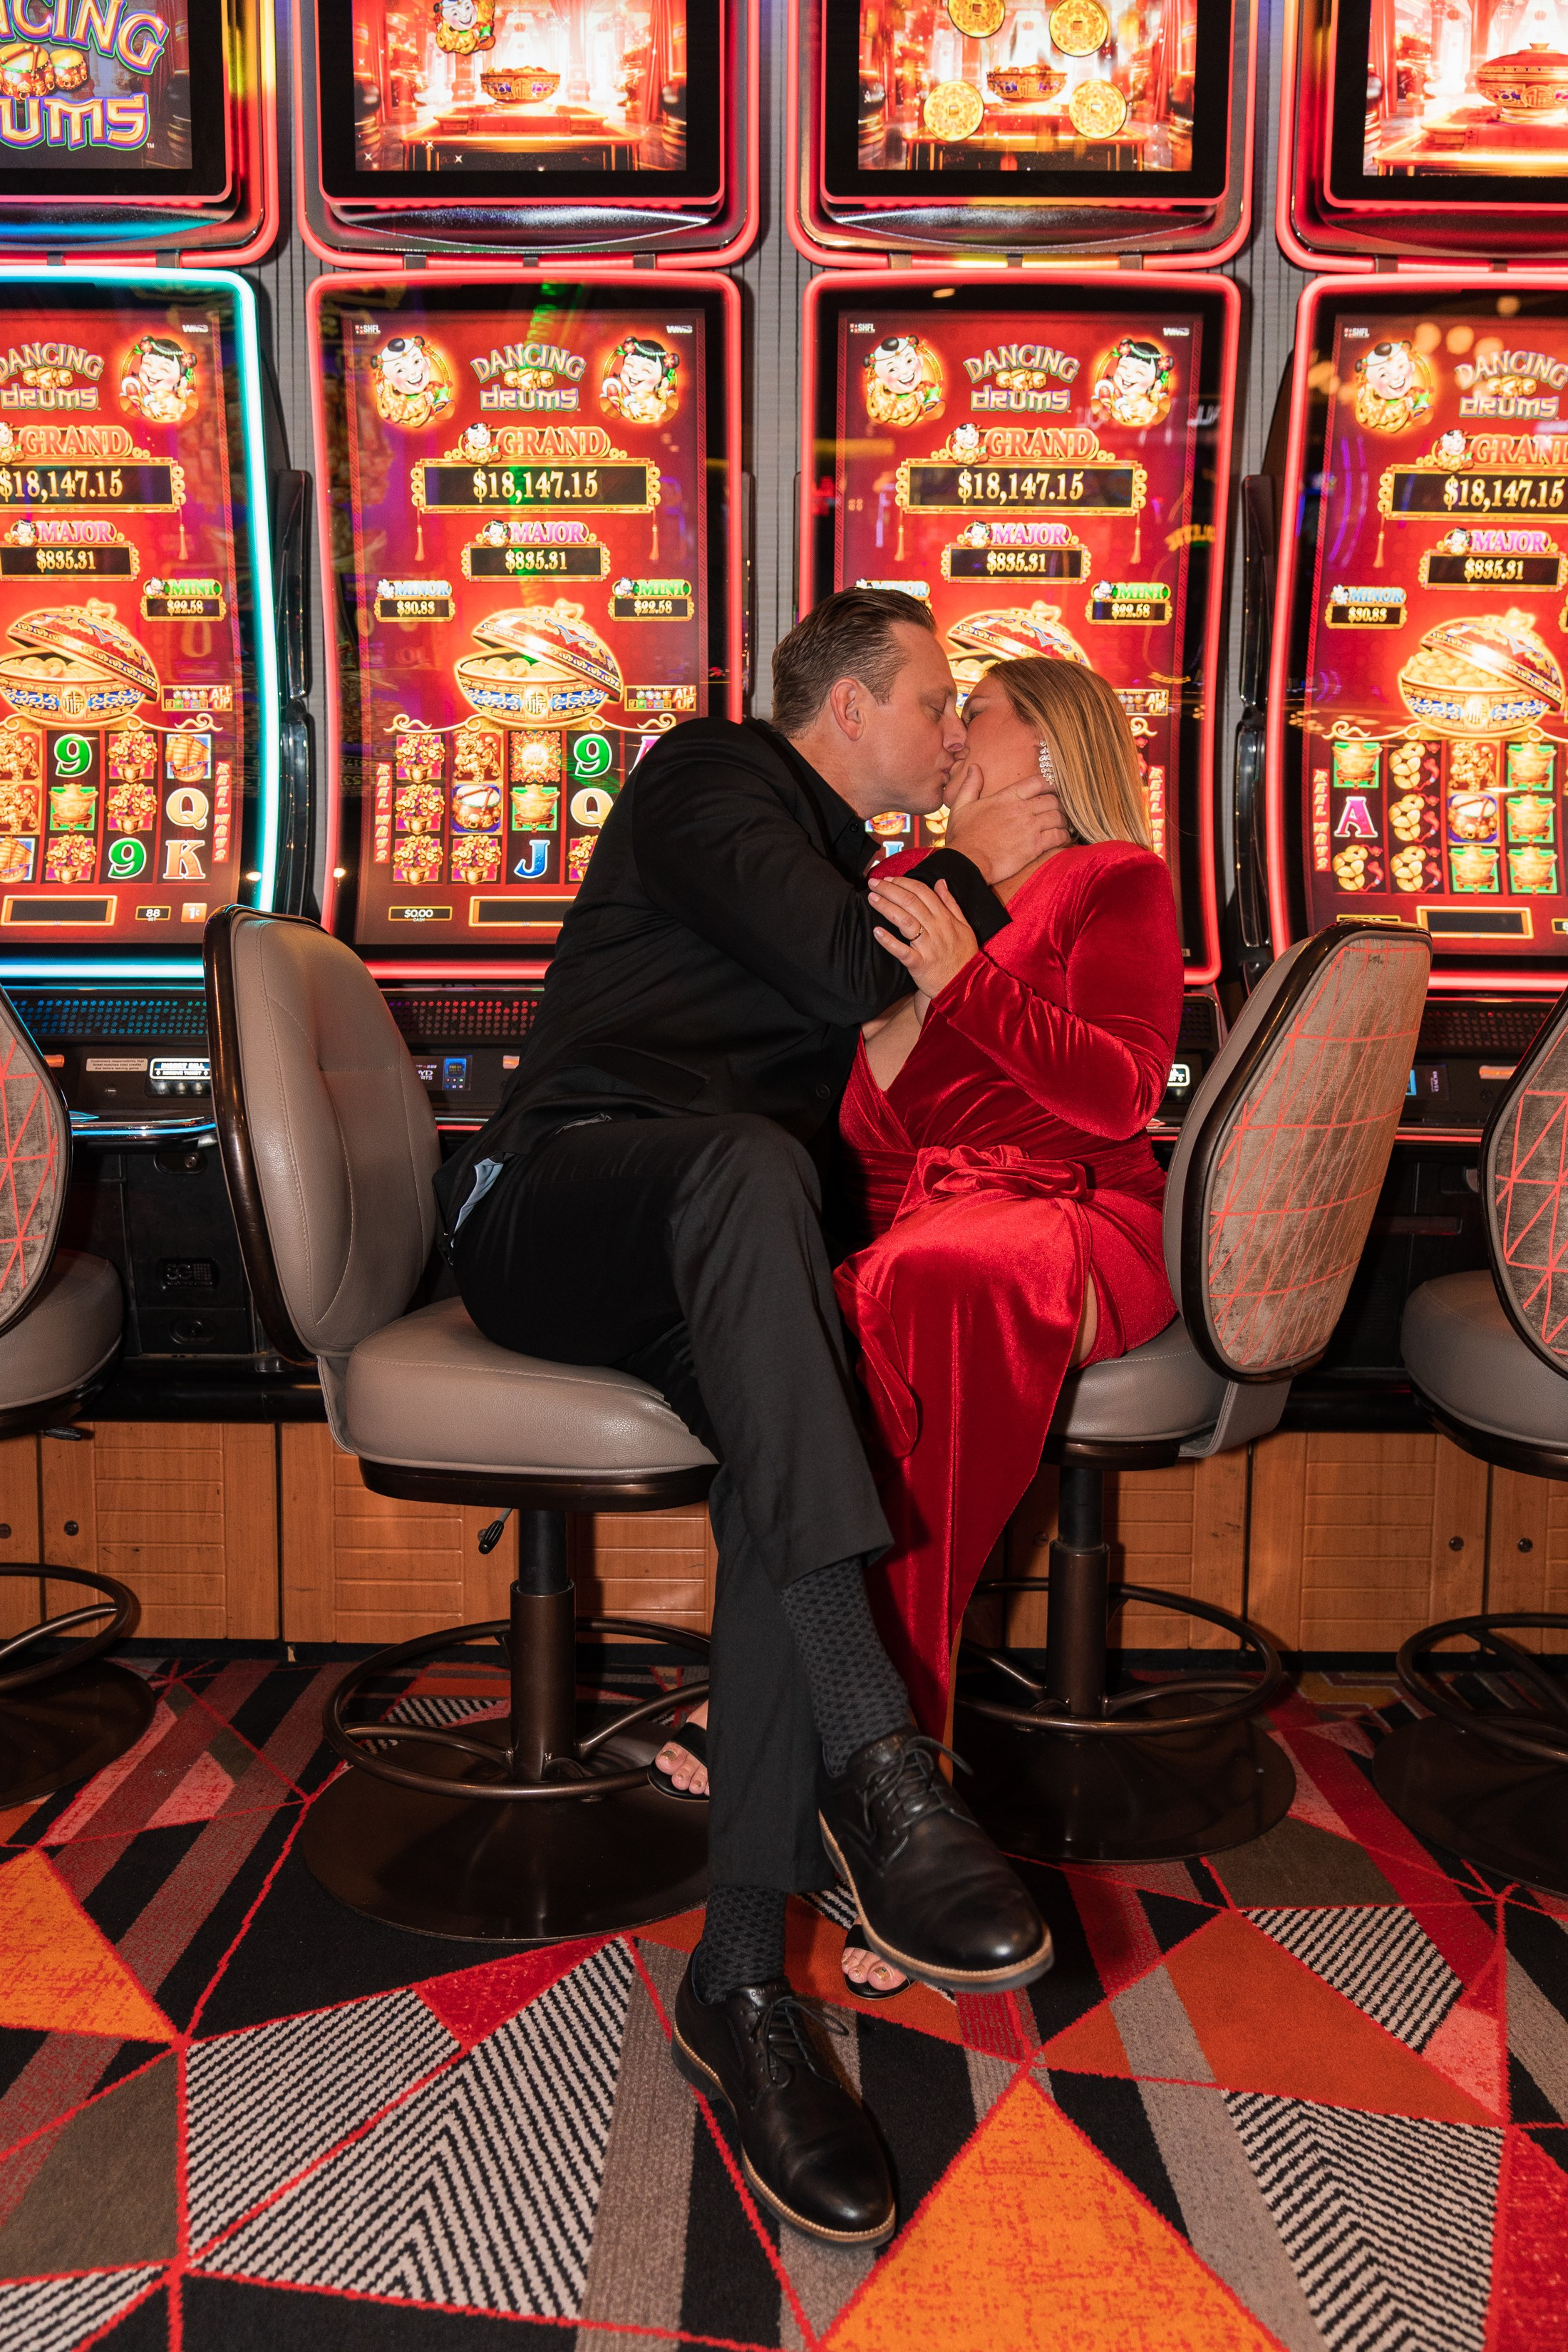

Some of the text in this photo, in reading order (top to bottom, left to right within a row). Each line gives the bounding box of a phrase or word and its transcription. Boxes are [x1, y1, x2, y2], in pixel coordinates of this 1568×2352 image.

[182, 324, 209, 333] WMS
[666, 325, 693, 334] WMS
[470, 344, 587, 383] DANCING
[964, 344, 1081, 383] DANCING
[1454, 350, 1568, 390] DANCING
[19, 425, 130, 458] GRAND
[499, 426, 607, 458] GRAND
[984, 428, 1096, 460] GRAND
[0, 468, 123, 502] $18,147.15
[473, 468, 598, 502] $18,147.15
[958, 469, 1084, 503] $18,147.15
[1443, 475, 1565, 512] $18,147.15
[37, 520, 114, 544] MAJOR
[508, 521, 585, 545] MAJOR
[991, 522, 1067, 547] MAJOR
[1472, 529, 1547, 554] MAJOR
[36, 549, 97, 573] $835.31
[505, 550, 567, 573] $835.31
[986, 550, 1046, 575] $835.31
[1463, 557, 1524, 582] $835.31
[167, 579, 216, 597] MINI
[394, 580, 450, 597] MINOR
[638, 579, 685, 597] MINI
[1116, 582, 1165, 600] MINI
[1349, 587, 1405, 603] MINOR
[166, 599, 204, 616] $22.58
[634, 599, 672, 617] $22.58
[1111, 604, 1150, 619] $22.58
[209, 686, 232, 703] ALL
[214, 696, 230, 709] UP
[672, 686, 696, 703] ALL
[677, 696, 694, 710] UP
[1145, 691, 1168, 706] ALL
[1150, 701, 1166, 713] UP
[54, 733, 92, 778] 9
[573, 733, 612, 778] 9
[166, 787, 210, 830] Q
[375, 763, 391, 862] REEL WAYS
[570, 788, 614, 829] Q
[1333, 796, 1378, 838] A
[214, 814, 231, 861] WAYS
[1314, 822, 1329, 870] WAYS
[108, 837, 147, 880] 9
[163, 840, 206, 880] K
[513, 840, 550, 879] J
[145, 908, 161, 918] 88
[404, 909, 434, 918] $0.00
